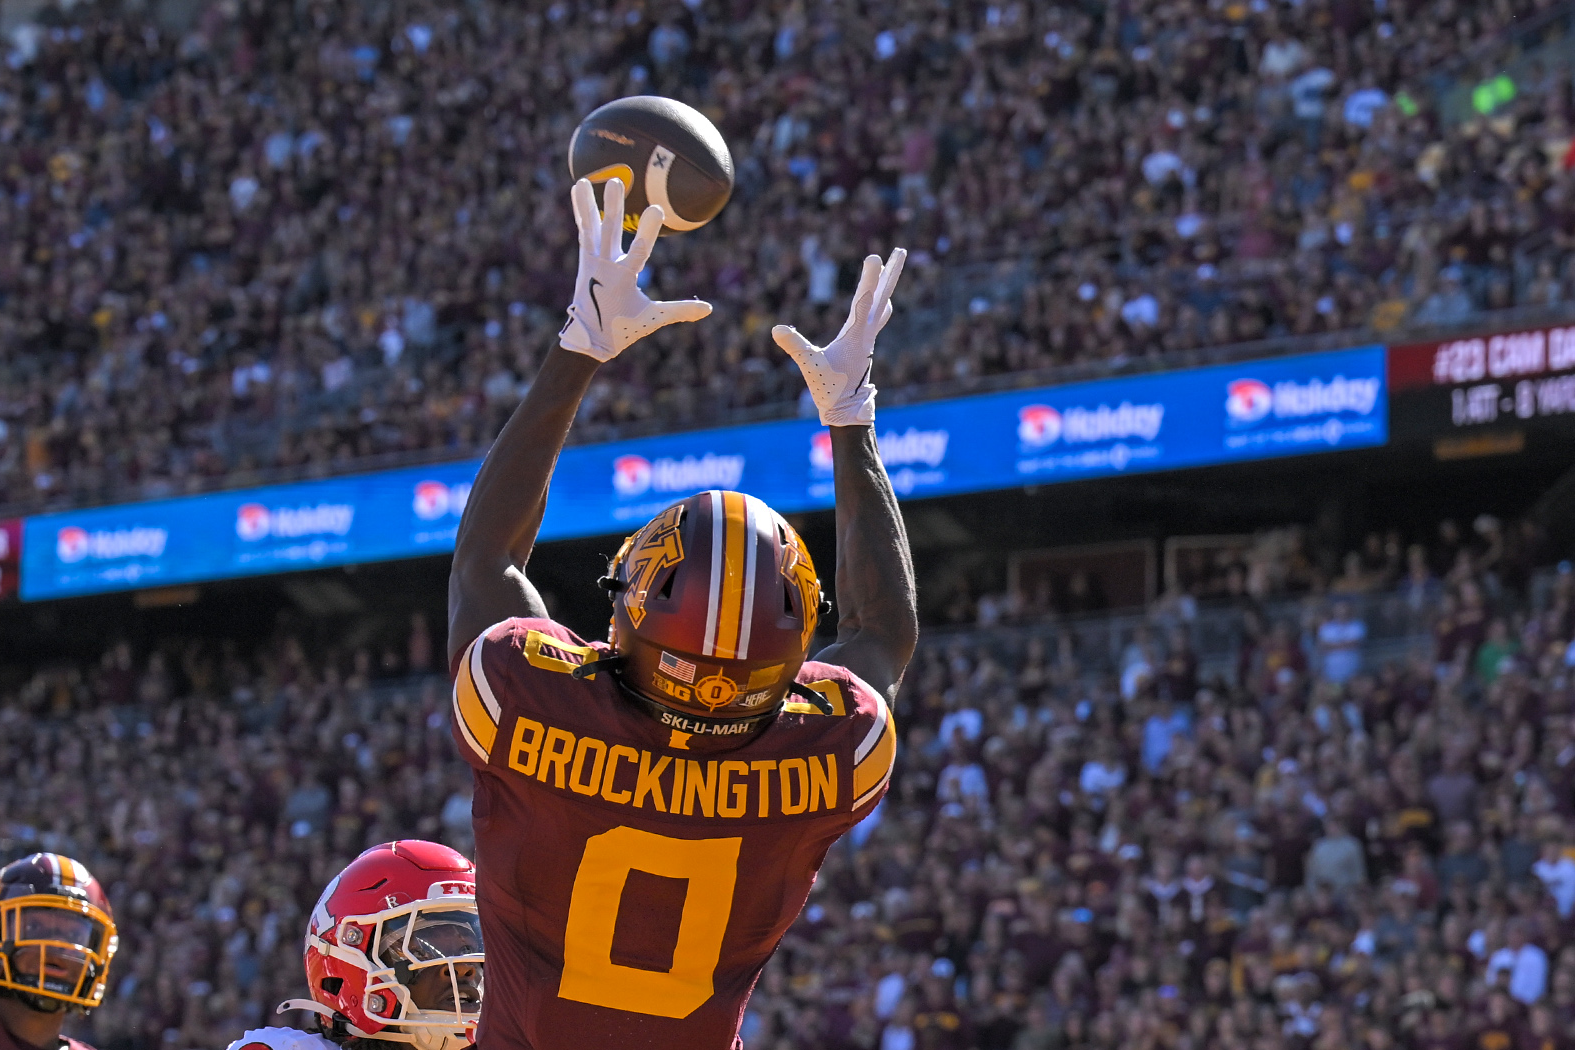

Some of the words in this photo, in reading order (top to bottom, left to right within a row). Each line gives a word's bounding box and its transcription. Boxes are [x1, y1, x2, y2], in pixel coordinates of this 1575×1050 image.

[1273, 375, 1380, 416] Holiday
[1063, 403, 1164, 442] Holiday
[652, 453, 745, 491] Holiday
[660, 712, 750, 735] SKI-U-MAH
[508, 715, 838, 819] BROCKINGTON
[557, 825, 743, 1020] 0
